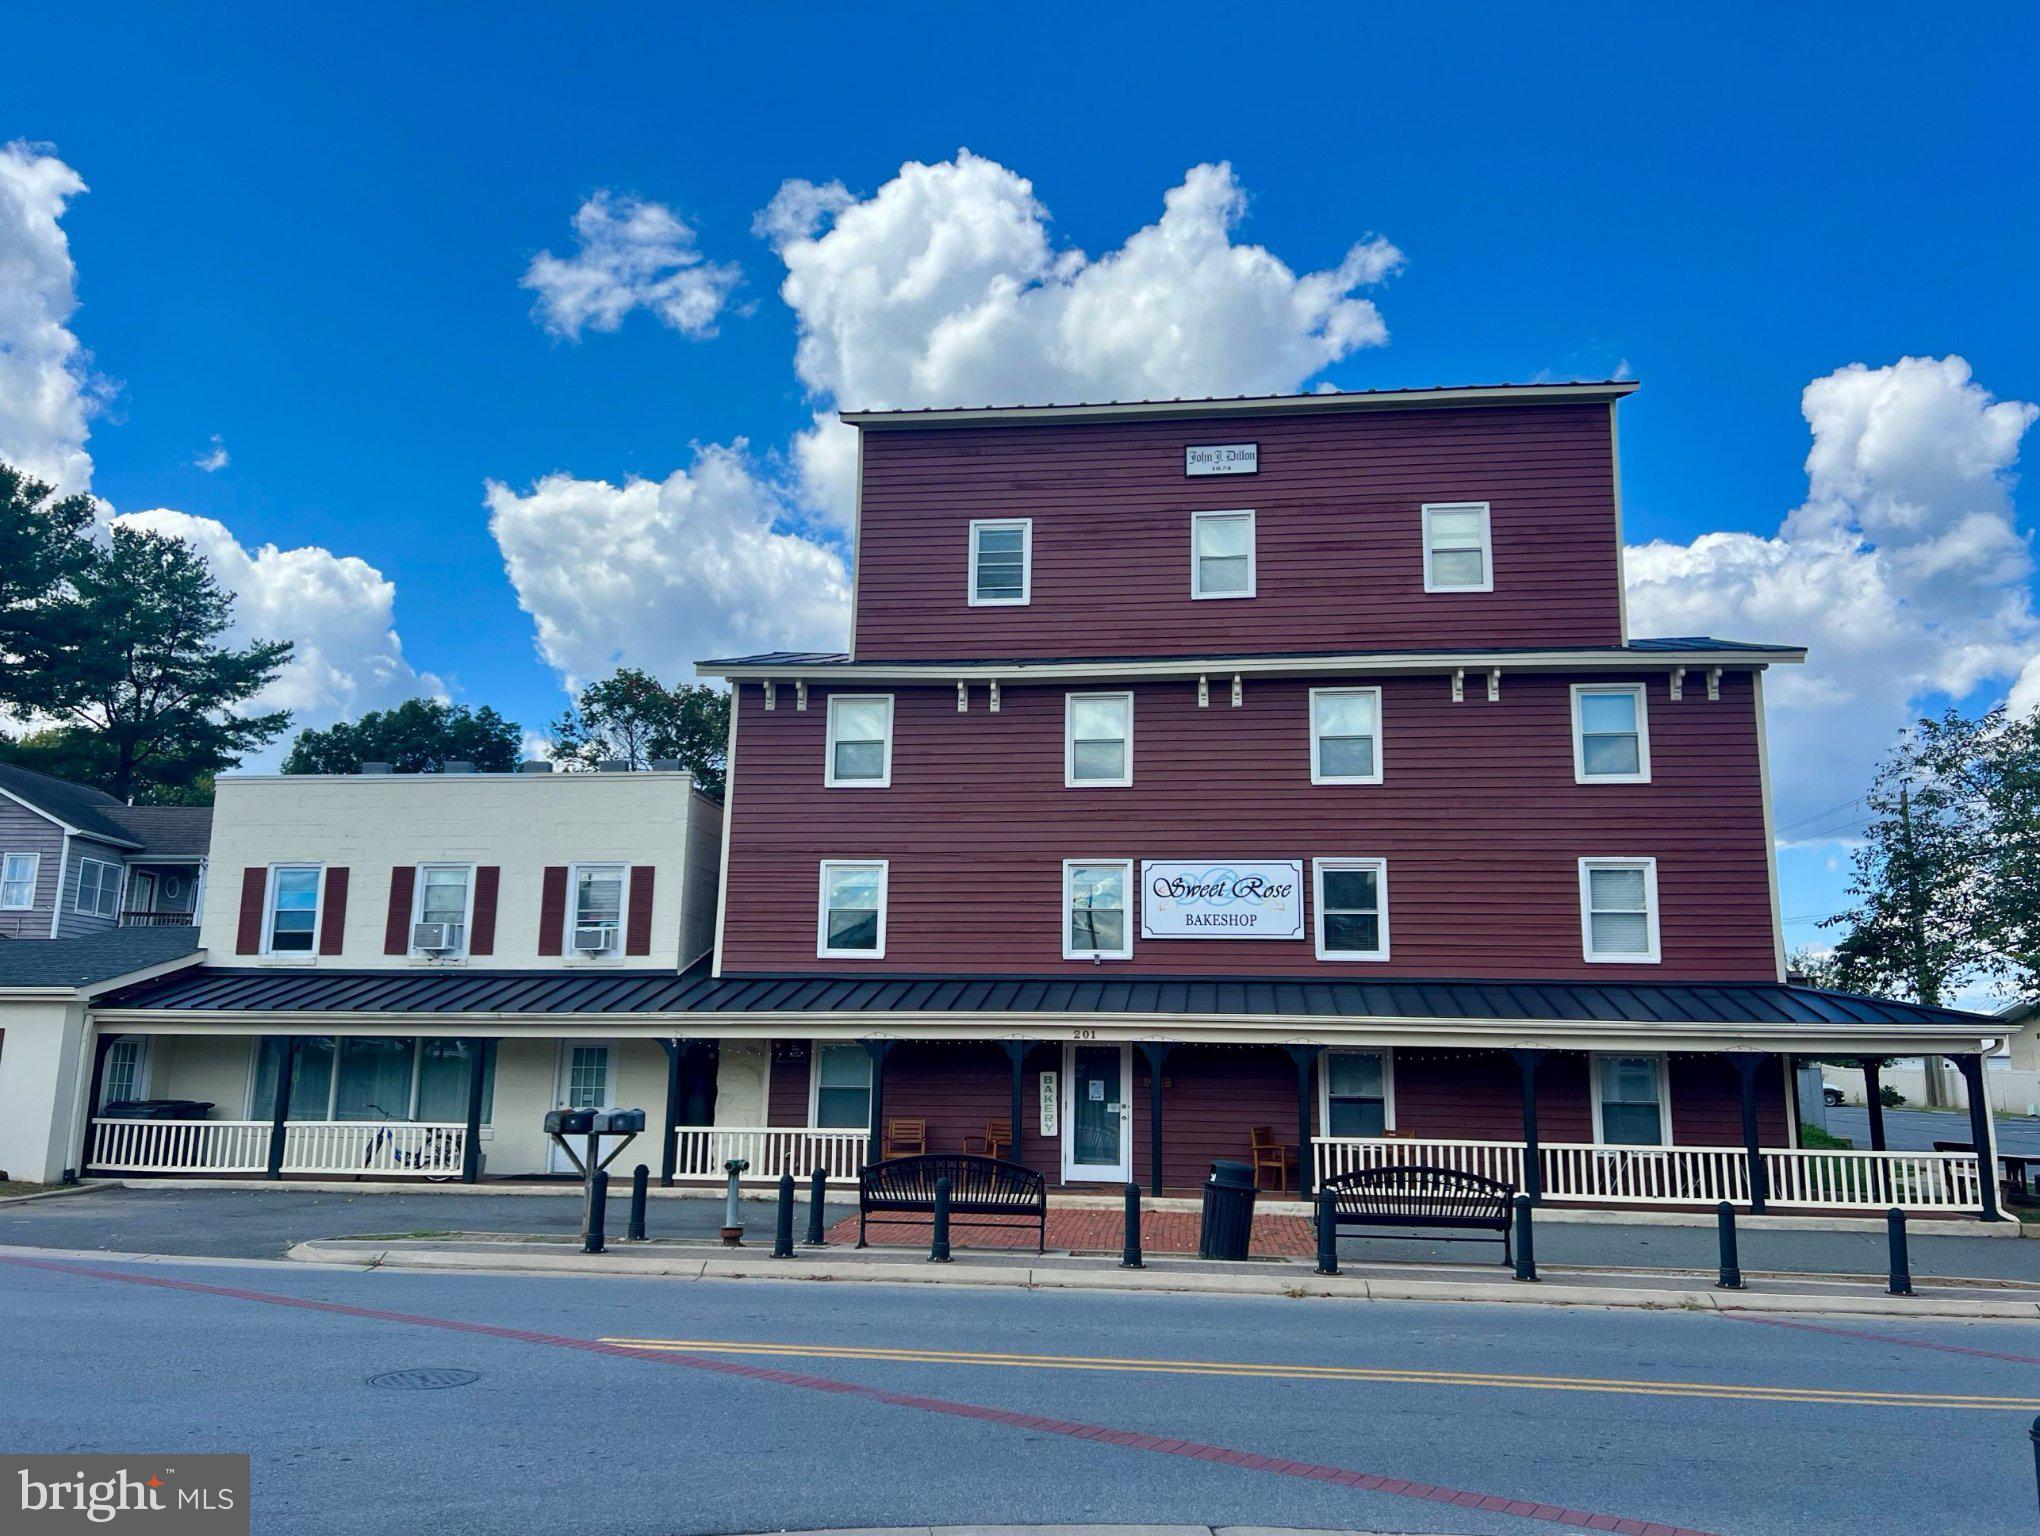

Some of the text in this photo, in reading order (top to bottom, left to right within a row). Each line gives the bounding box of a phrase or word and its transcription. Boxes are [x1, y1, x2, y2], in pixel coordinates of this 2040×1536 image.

[1189, 450, 1213, 465] John
[1226, 450, 1256, 461] Dillon
[1153, 877, 1292, 899] Sweet Rose
[1185, 914, 1258, 927] BAKESHOP
[1073, 1029, 1096, 1039] 201
[1043, 1075, 1054, 1132] BAKERY
